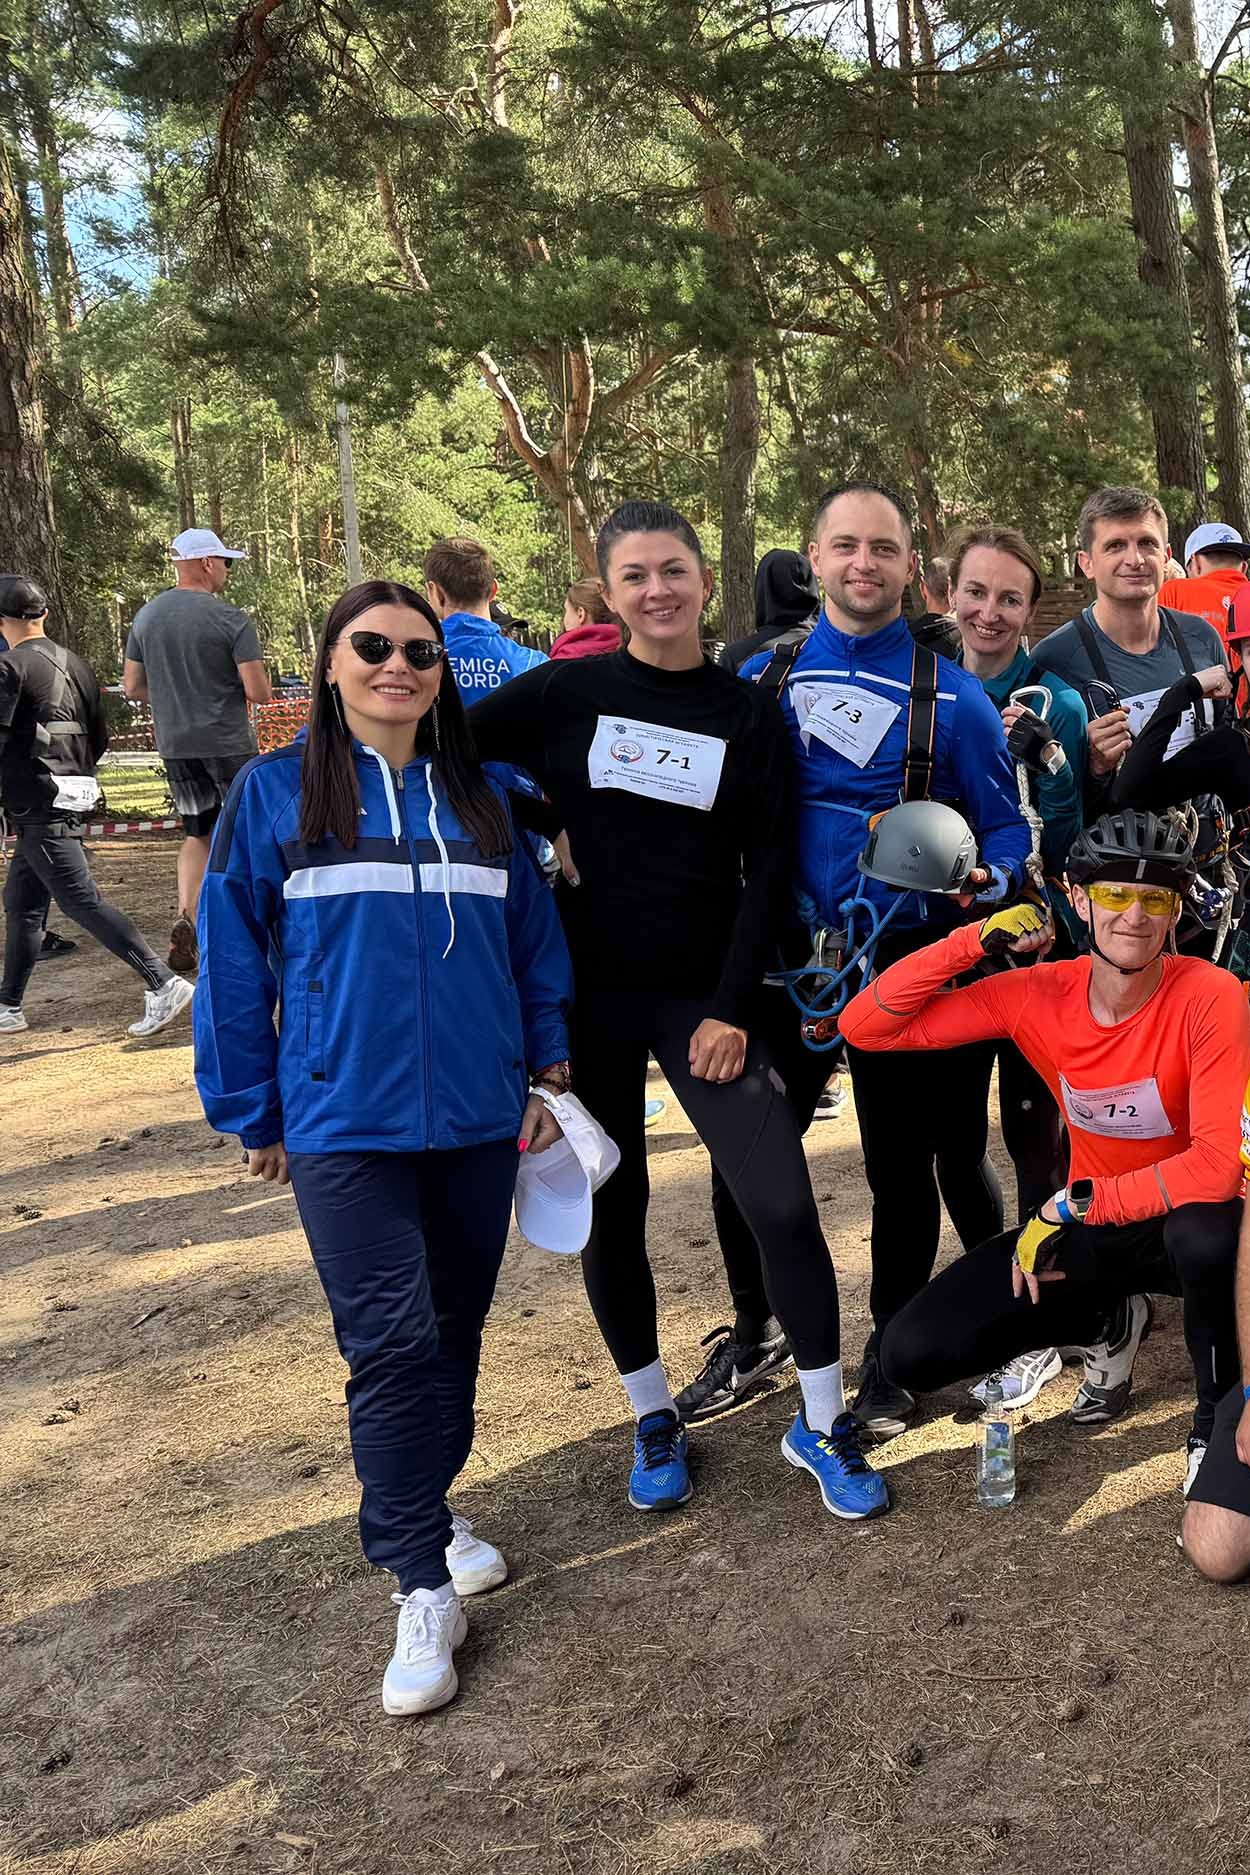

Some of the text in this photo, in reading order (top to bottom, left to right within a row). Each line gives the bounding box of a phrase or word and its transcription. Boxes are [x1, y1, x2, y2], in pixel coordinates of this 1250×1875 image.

[831, 699, 863, 724] 7-3
[656, 748, 692, 771] 7-1
[1103, 1103, 1139, 1118] 7-2
